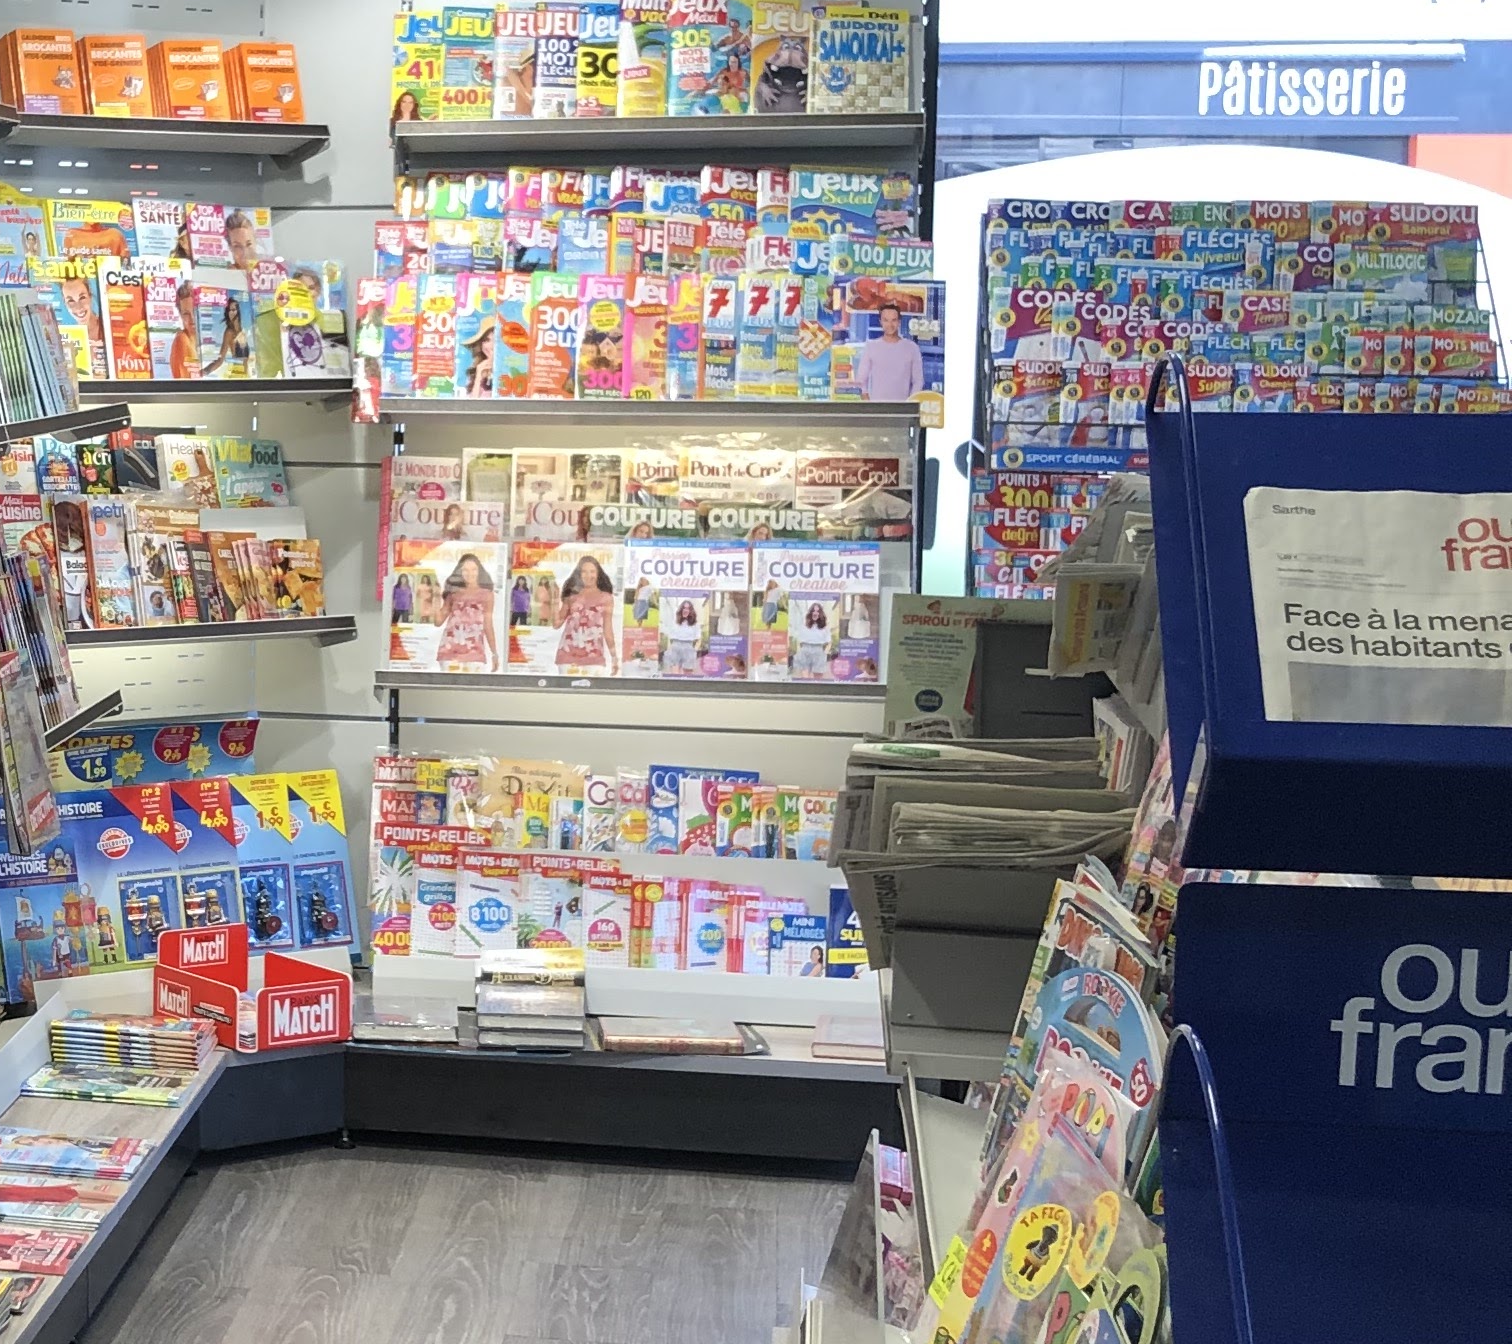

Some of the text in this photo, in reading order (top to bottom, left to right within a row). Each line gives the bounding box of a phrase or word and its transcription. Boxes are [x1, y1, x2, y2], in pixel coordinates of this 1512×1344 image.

[830, 20, 899, 32] SUDOKU
[22, 42, 72, 54] BROCANTES
[670, 30, 711, 48] 305
[91, 49, 142, 60] BROCANTES
[169, 54, 219, 64] BROCANTES
[248, 57, 295, 67] BROCANTES
[442, 90, 479, 105] 400
[1198, 61, 1406, 116] Pâtisserie
[800, 171, 878, 198] Jeux
[52, 201, 115, 221] Bien-être
[1007, 203, 1050, 219] CRO
[1255, 203, 1302, 219] MOTS
[1389, 206, 1476, 223] SUDOKU
[189, 213, 225, 233] Santé
[853, 244, 932, 266] 100 JEUX
[1356, 253, 1426, 271] MULTILOGIC
[33, 257, 97, 279] santé
[147, 283, 176, 301] Santé
[749, 285, 770, 316] 7
[709, 286, 730, 319] 7
[1254, 364, 1308, 377] SUDOKU
[1197, 380, 1232, 393] Super
[250, 447, 278, 466] food
[1026, 453, 1120, 464] SPORT CÉRÉBRAL
[405, 464, 436, 478] MONDE
[439, 465, 451, 478] DU
[805, 466, 897, 484] Point Croix
[399, 500, 501, 526] Couure
[1272, 504, 1316, 516] Sarthe
[708, 510, 816, 531] COUTURE
[640, 559, 745, 577] COUTURE
[768, 561, 875, 580] COUTURE
[902, 614, 950, 628] SPIROU
[1284, 603, 1360, 630] Face
[1367, 607, 1387, 630] à
[1394, 609, 1419, 631] la
[1286, 631, 1502, 659] des habitants
[384, 827, 486, 845] POINTS RELIER
[421, 853, 452, 865] MOTS
[532, 856, 614, 872] POINTS RELIER
[471, 906, 508, 922] 8100
[182, 935, 225, 964] MATCH
[159, 986, 188, 1015] MATCH
[273, 994, 334, 1038] MATCH
